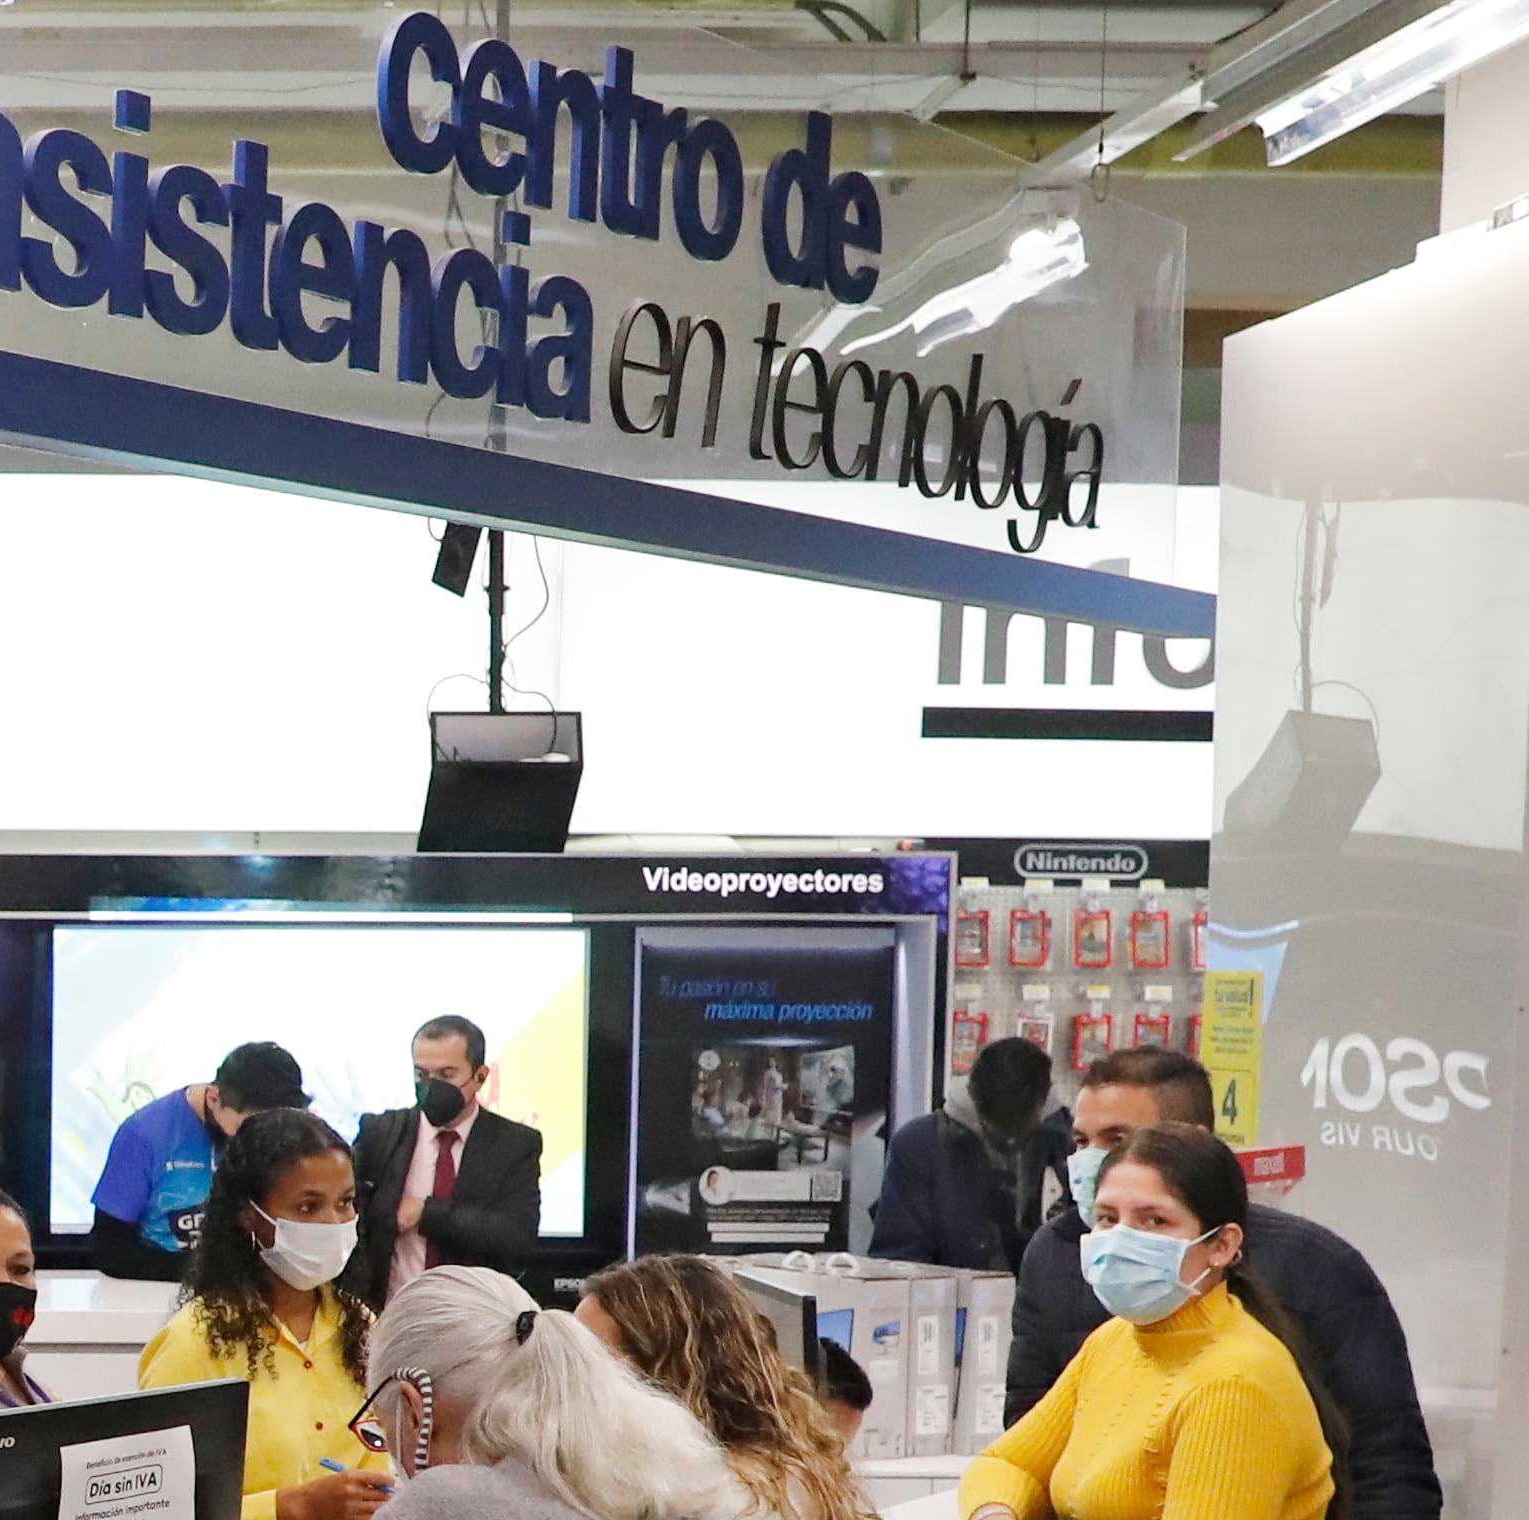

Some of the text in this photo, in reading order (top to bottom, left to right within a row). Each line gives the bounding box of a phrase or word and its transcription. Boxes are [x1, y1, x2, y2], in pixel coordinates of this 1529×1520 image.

[378, 10, 883, 304] centro de
[609, 301, 725, 448] en
[749, 302, 1104, 553] tecnología
[1025, 852, 1136, 873] Nintendo
[642, 866, 884, 898] Videoproyectores
[704, 1000, 874, 1023] máxima proyección
[89, 1471, 158, 1498] Día sin IVA
[125, 1499, 170, 1516] importante
